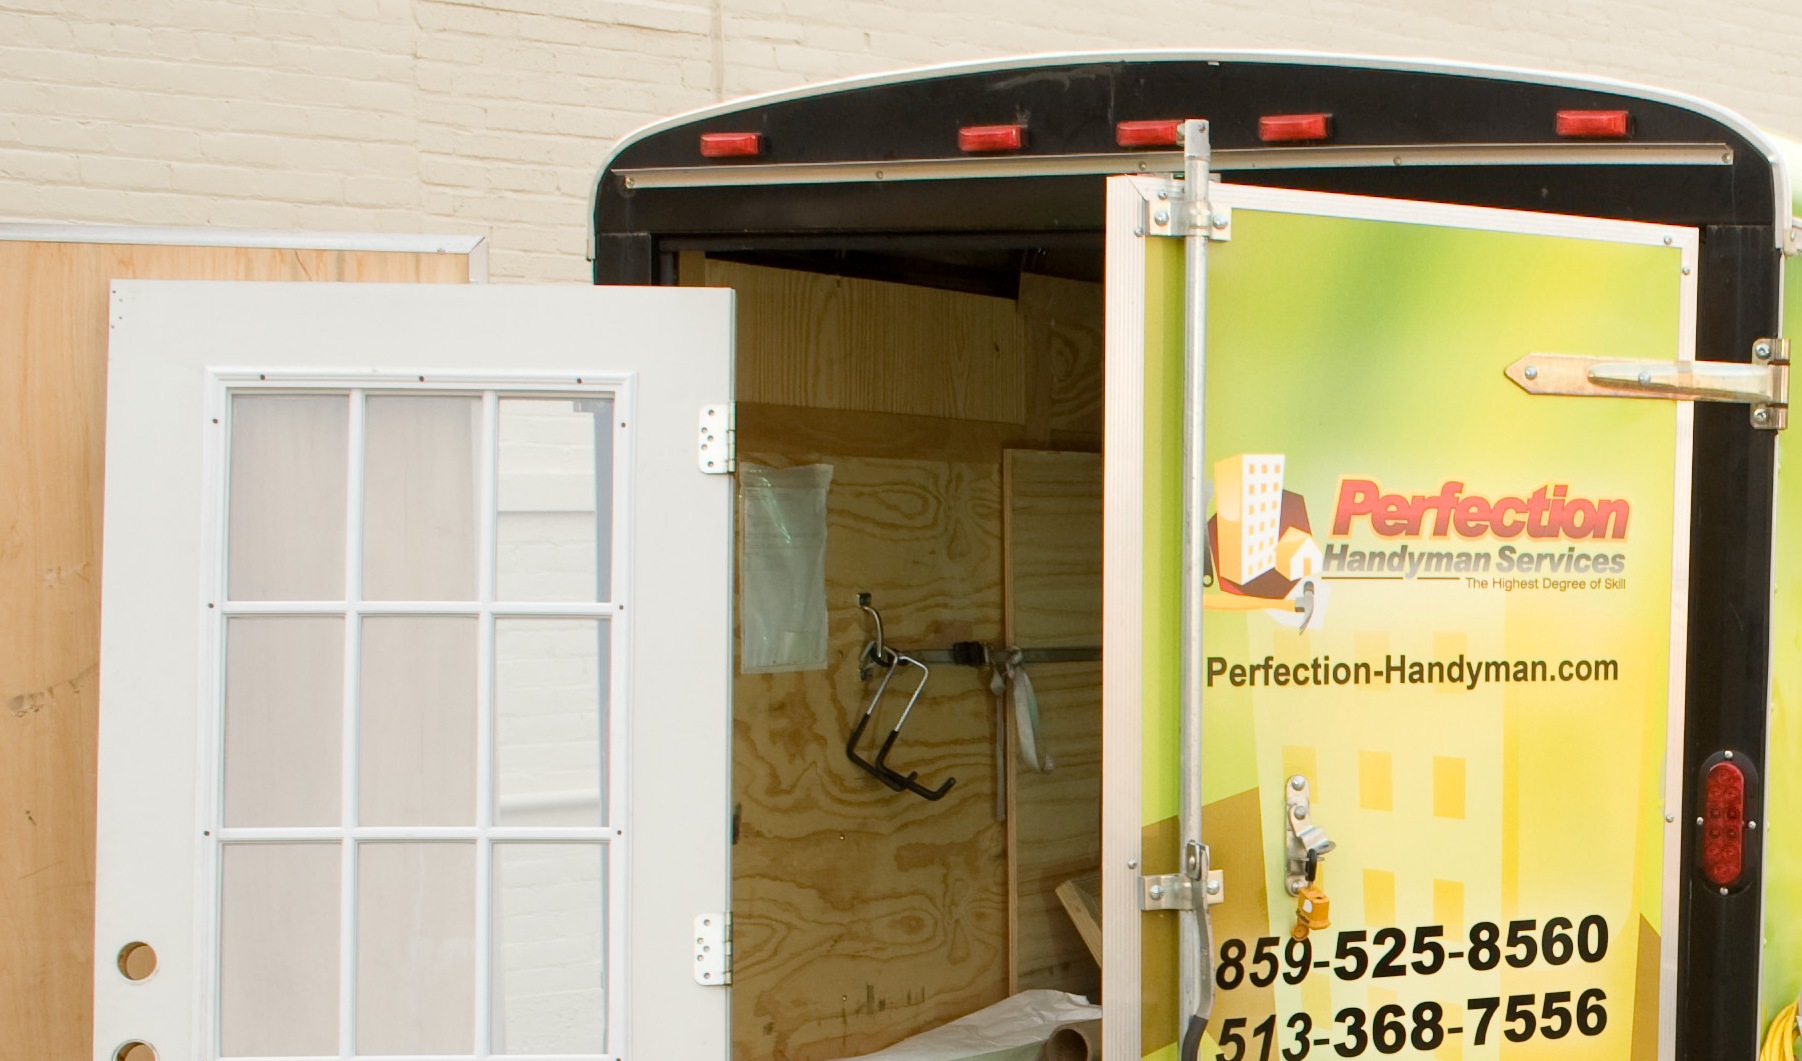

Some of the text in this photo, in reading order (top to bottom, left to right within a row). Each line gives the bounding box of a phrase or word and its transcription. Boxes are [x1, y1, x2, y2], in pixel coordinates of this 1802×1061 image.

[1332, 479, 1629, 540] Perfection
[1322, 543, 1626, 577] Handyman Services
[1465, 577, 1626, 592] The Highest Degree of Skill
[1206, 655, 1619, 690] Perfection-Handyman.com
[1215, 914, 1609, 990] 859-525-8560
